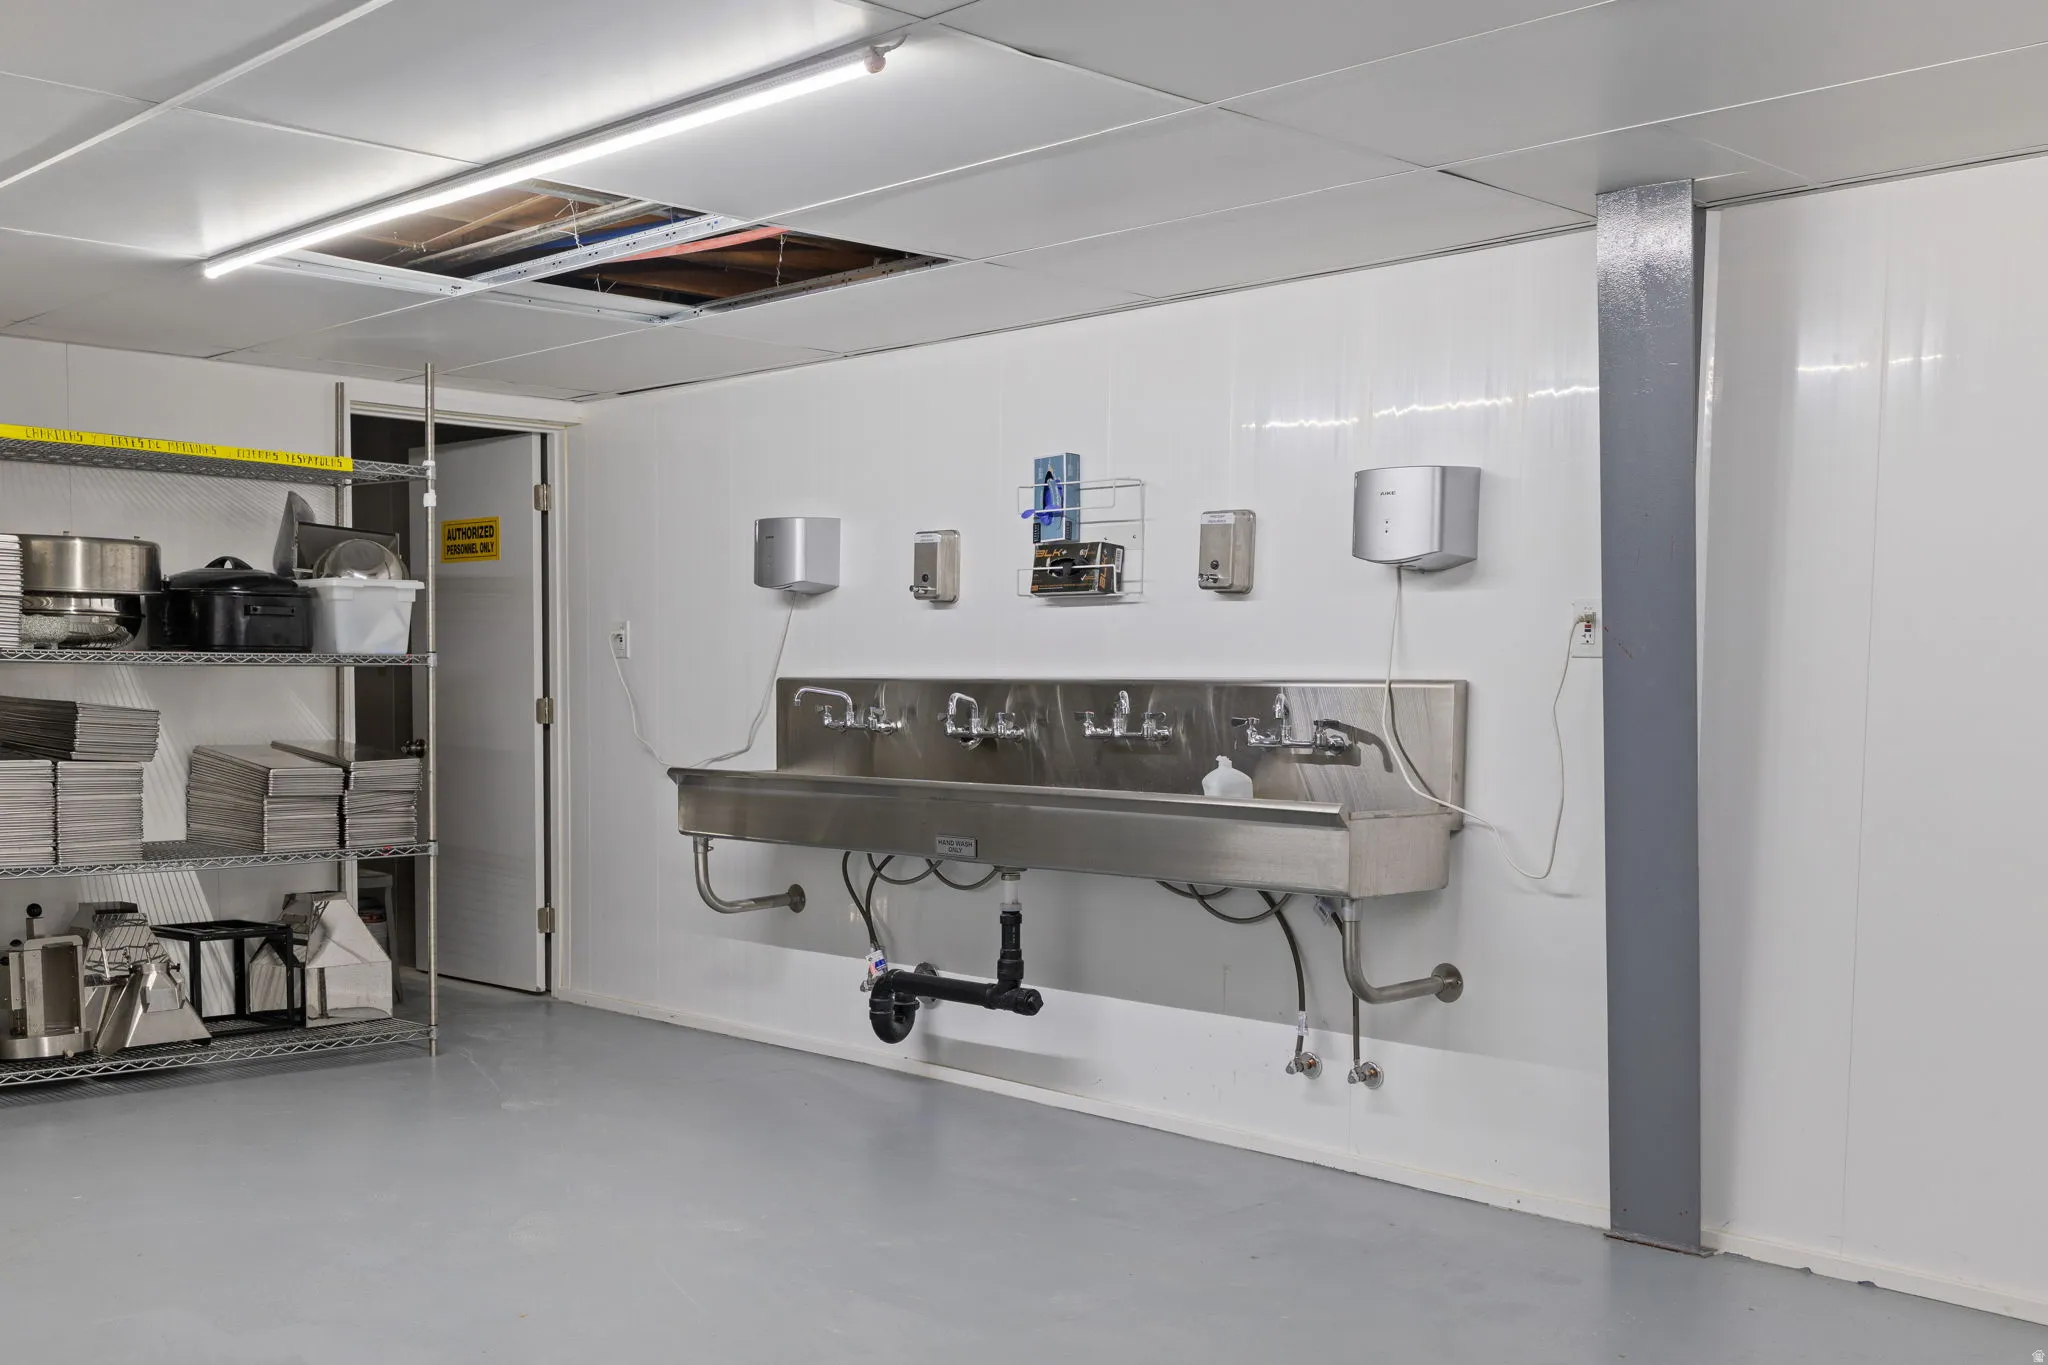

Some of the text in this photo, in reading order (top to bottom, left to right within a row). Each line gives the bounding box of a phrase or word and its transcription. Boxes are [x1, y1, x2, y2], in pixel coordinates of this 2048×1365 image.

[447, 525, 495, 541] AUTHORIZED
[446, 541, 495, 556] PERSONNEL ONLY
[938, 839, 973, 848] HAND WASH
